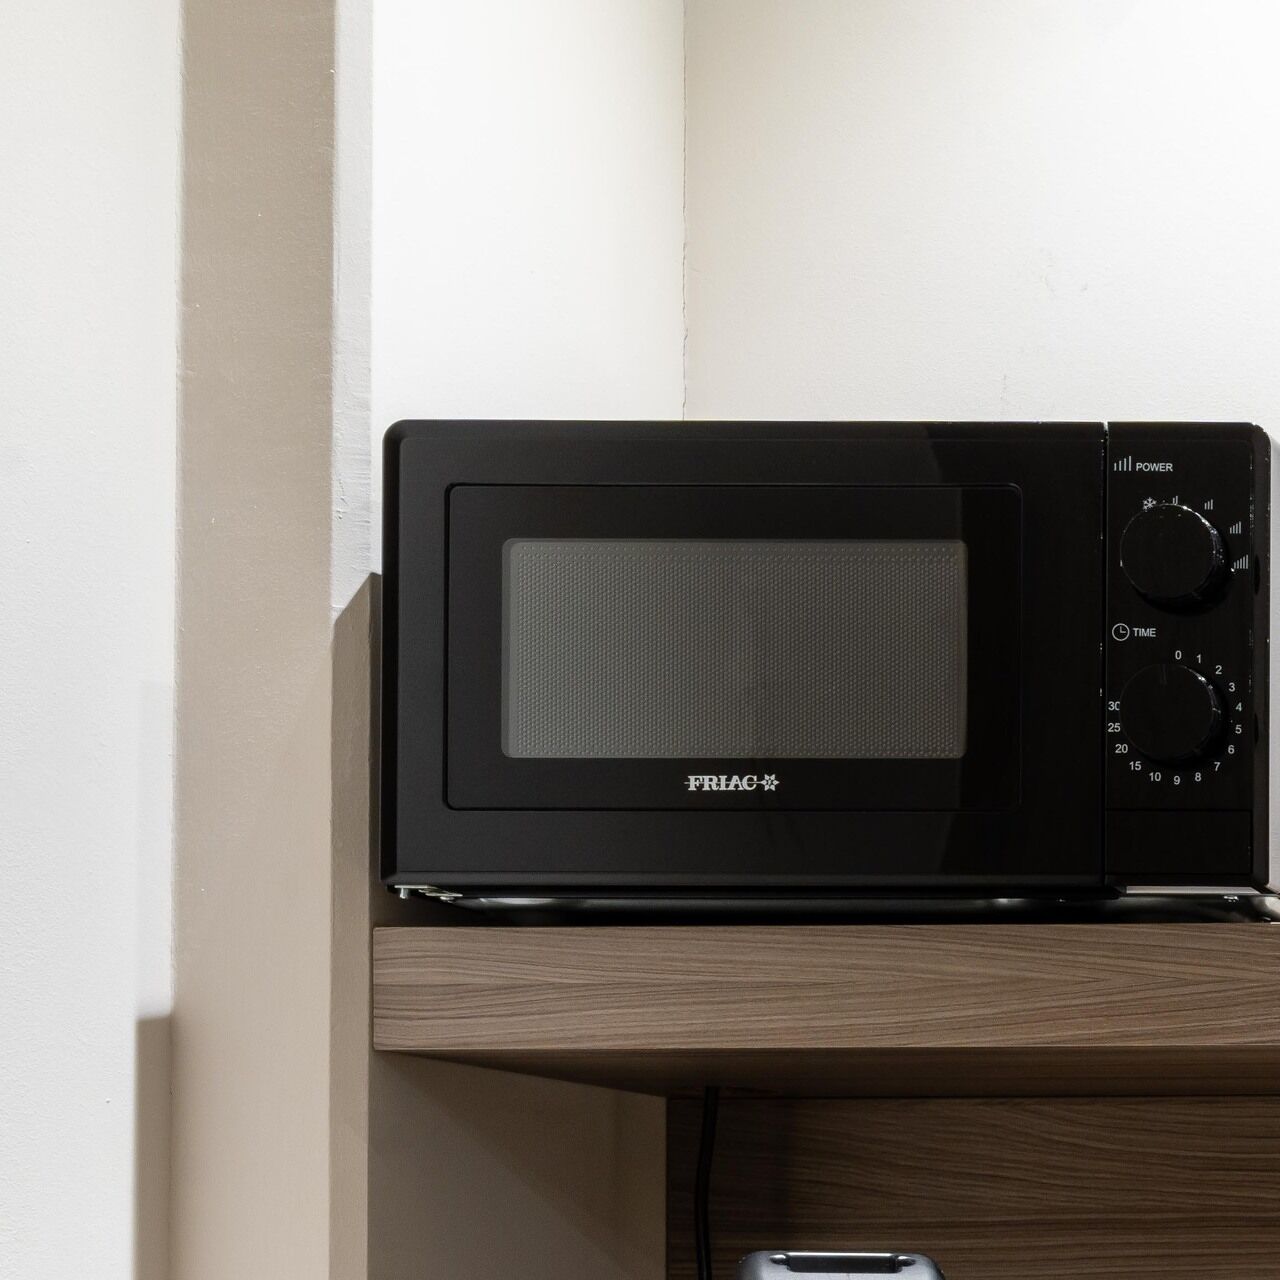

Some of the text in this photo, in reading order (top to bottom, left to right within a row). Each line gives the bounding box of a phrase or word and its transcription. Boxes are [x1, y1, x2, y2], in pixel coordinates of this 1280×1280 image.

[1135, 462, 1174, 472] POWER
[1132, 627, 1157, 638] TIME
[1174, 650, 1182, 660] 0
[1196, 653, 1202, 664] 1
[1215, 665, 1223, 675] 2
[1228, 682, 1236, 692] 3
[1107, 701, 1121, 711] 30
[1235, 702, 1243, 711] 4
[1107, 723, 1121, 733] 25
[1235, 724, 1242, 734] 5
[1115, 744, 1129, 754] 20
[1227, 744, 1235, 754] 6
[1129, 761, 1142, 771] 15
[1214, 761, 1221, 771] 7
[1149, 772, 1162, 781] 10
[1173, 775, 1181, 785] 9
[1194, 772, 1202, 782] 8
[687, 774, 758, 791] FRIAC
